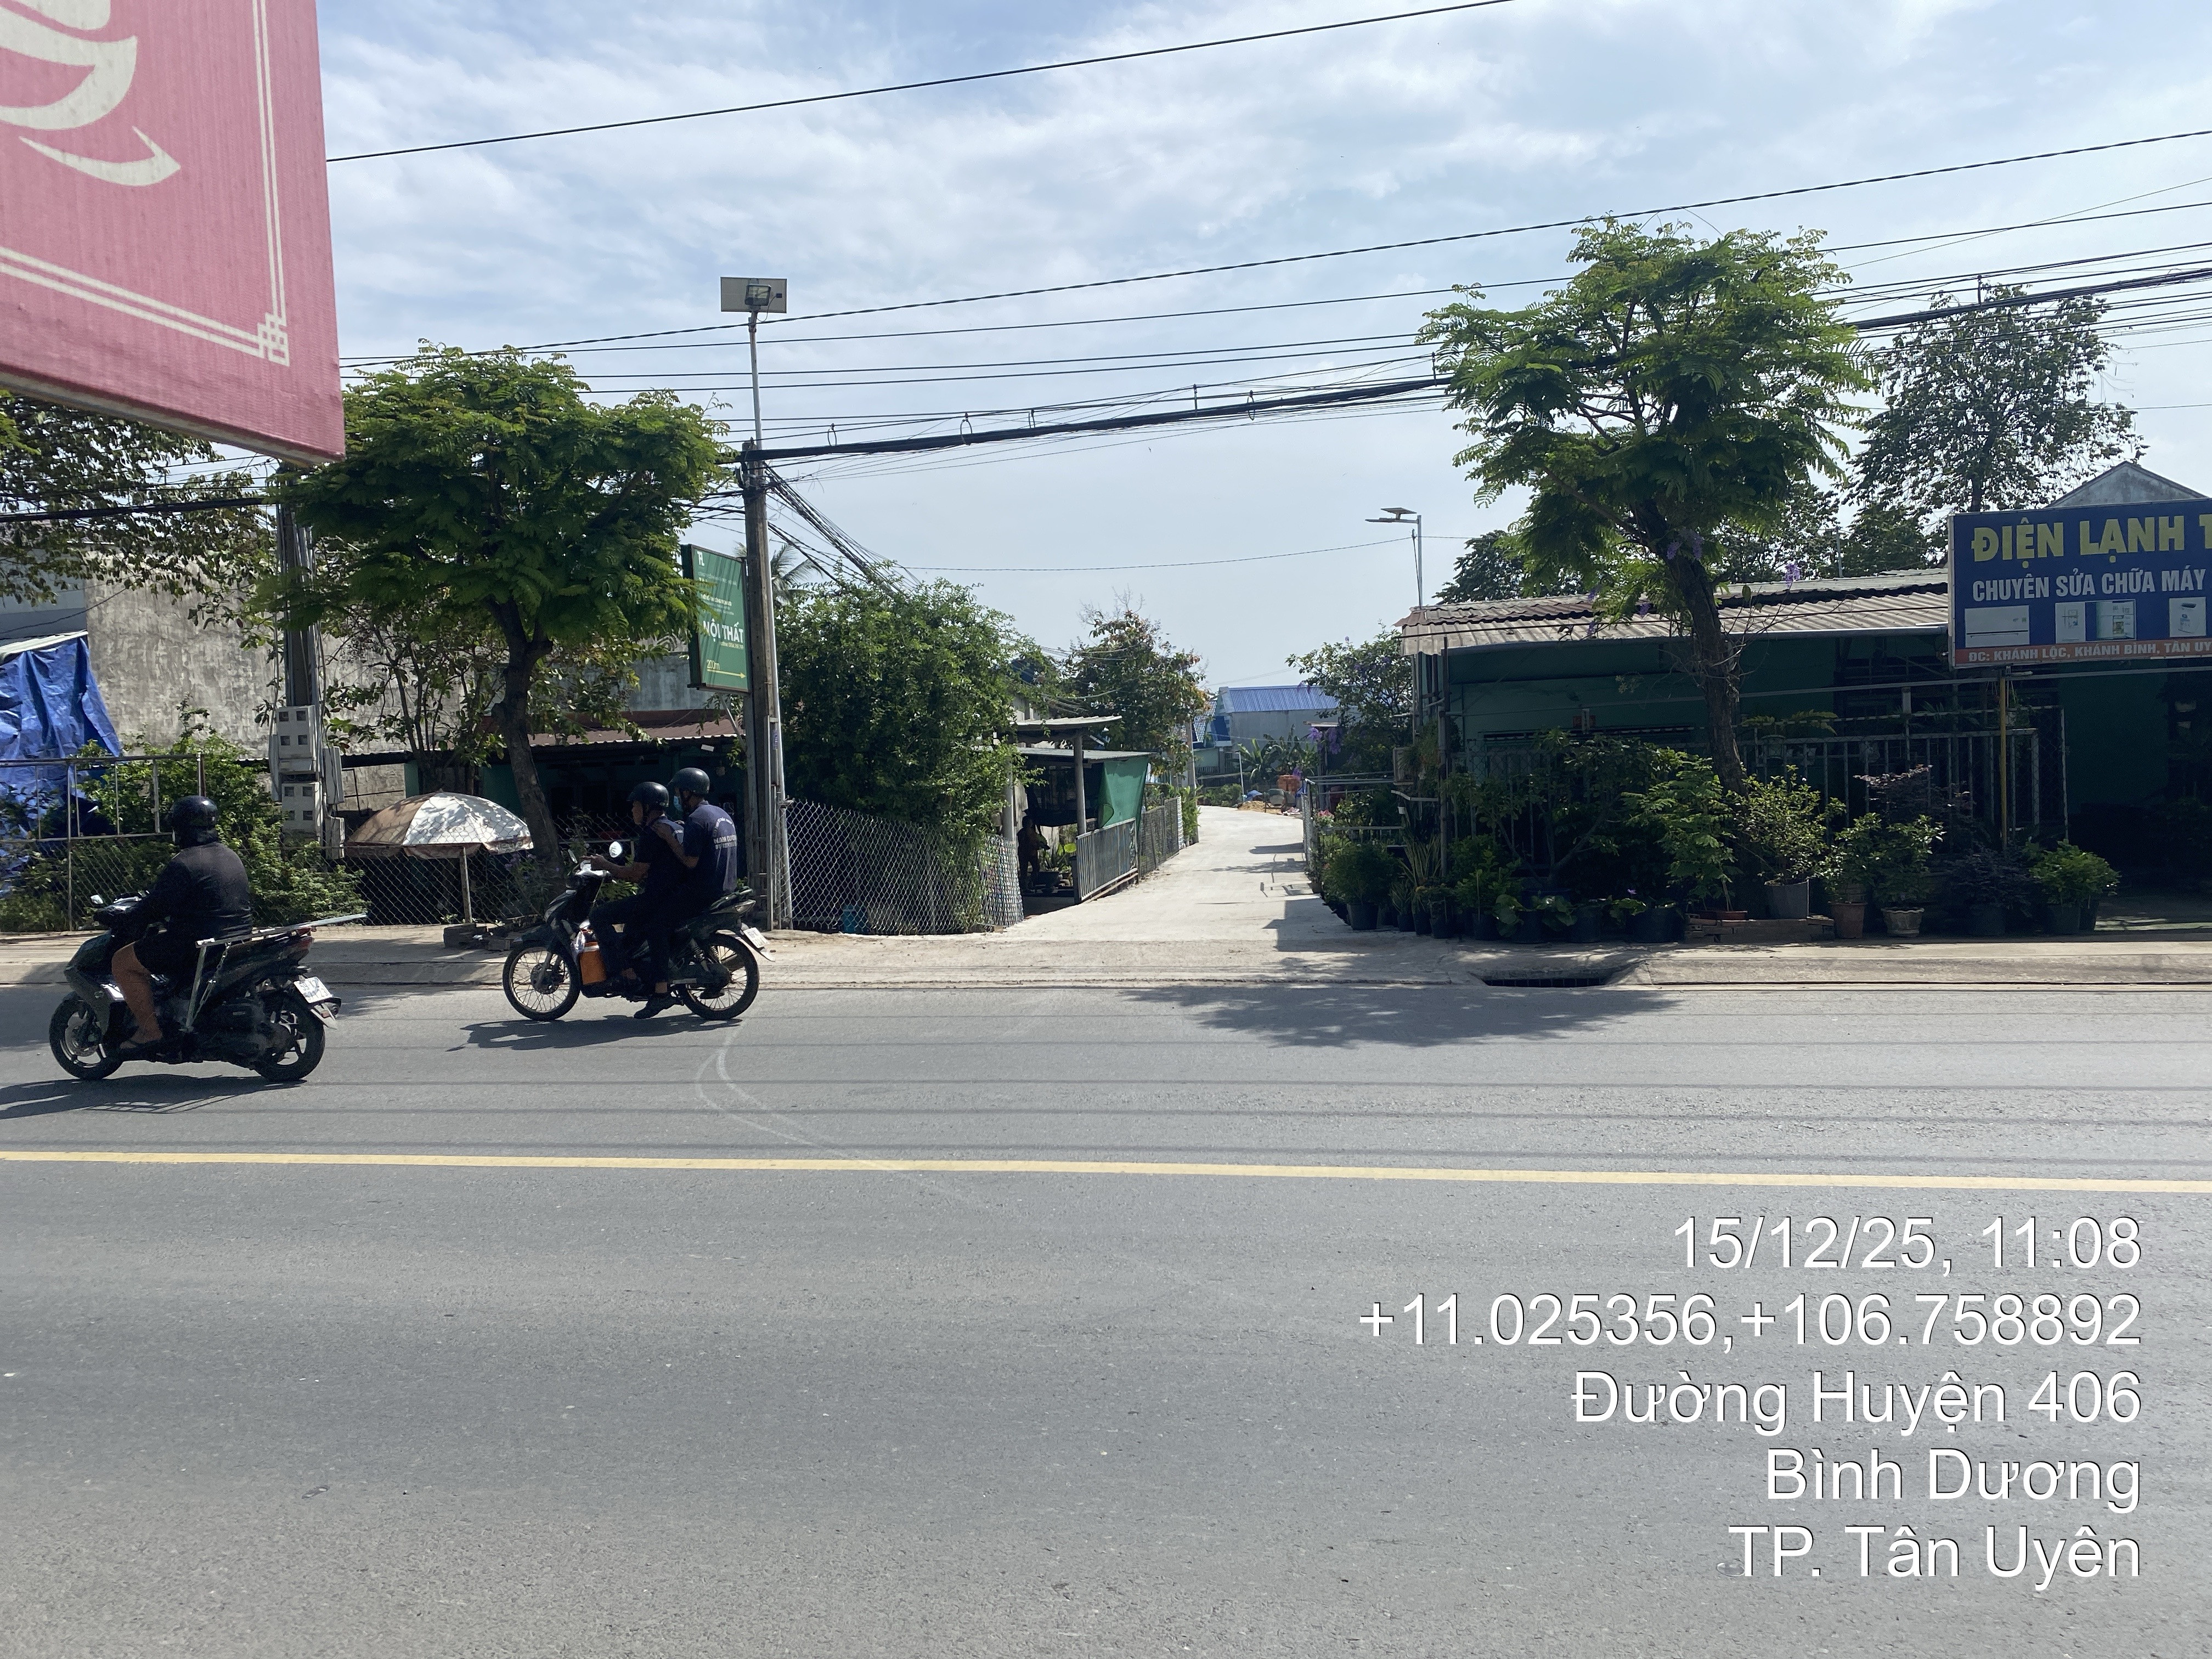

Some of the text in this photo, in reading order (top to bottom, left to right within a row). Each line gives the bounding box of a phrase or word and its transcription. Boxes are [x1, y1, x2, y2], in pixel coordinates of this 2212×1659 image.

[1971, 517, 2064, 569] ĐIỆN
[2079, 515, 2186, 563] LẠNH
[1972, 565, 2207, 602] CHUYÊN SỬA CHỮA MÁY
[703, 618, 744, 644] NỘI THẤT
[706, 659, 720, 670] 200m
[1968, 651, 1990, 663] ĐC:
[1994, 647, 2038, 662] KHÁNH
[2042, 646, 2071, 660] LỘC,
[2075, 644, 2120, 658] KHÁNH
[2164, 640, 2191, 653] TÂN
